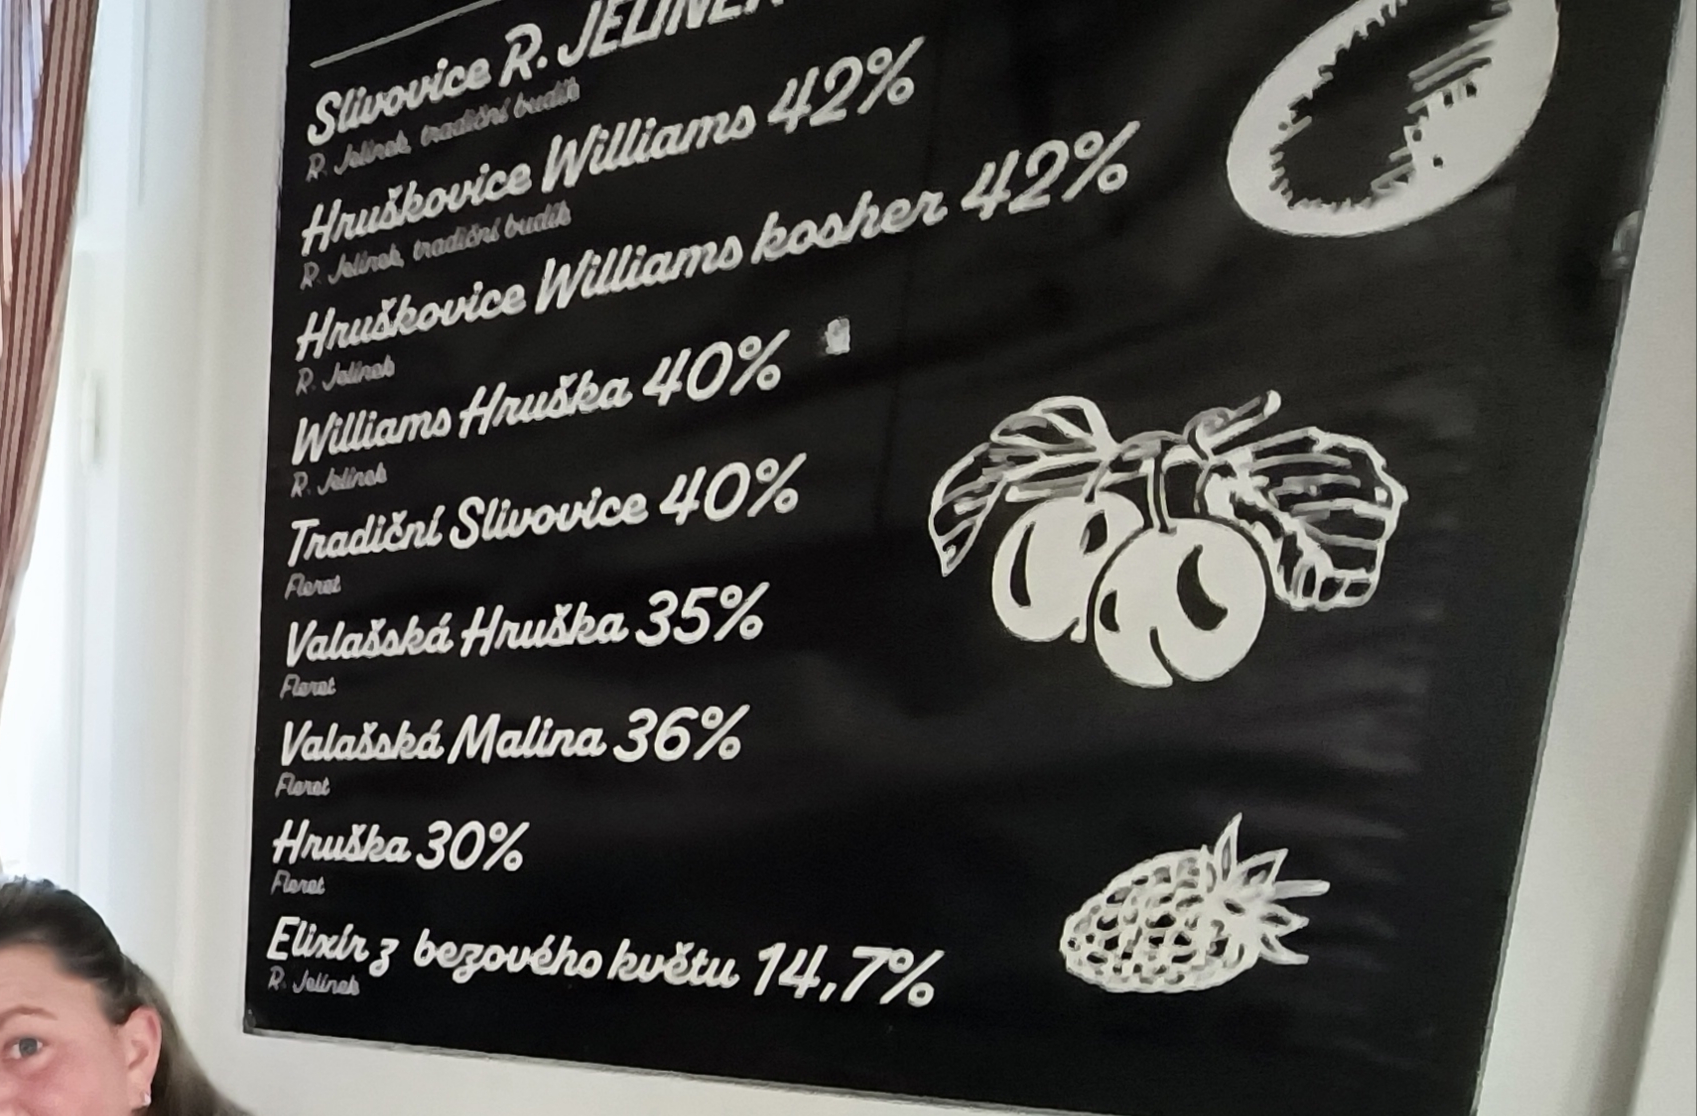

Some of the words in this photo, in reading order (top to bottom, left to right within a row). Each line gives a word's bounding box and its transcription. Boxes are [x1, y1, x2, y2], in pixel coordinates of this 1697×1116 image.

[307, 57, 491, 145] Slivovice
[499, 23, 547, 88] R.
[301, 163, 532, 256] Hruškovice
[542, 105, 756, 193] Williams
[767, 36, 926, 133] 42%
[295, 281, 526, 362] Hruškovice
[537, 238, 743, 312] Williams
[751, 193, 948, 265] kosher
[962, 121, 1140, 218] 42%
[291, 407, 452, 465] Williams
[459, 370, 634, 438] Hruška
[643, 329, 790, 406] 40%
[287, 504, 445, 567] Tradiční
[449, 487, 649, 549] Slivovice
[659, 452, 807, 526] 40%
[286, 612, 454, 667] Valašská
[460, 604, 628, 657] Hruška
[635, 581, 770, 647] 35%
[281, 719, 445, 766] Valašská
[449, 713, 607, 764] Malina
[613, 704, 750, 762] 36%
[272, 819, 412, 864] Hruška
[416, 820, 530, 871] 30%
[266, 916, 369, 962] Elixír
[369, 938, 400, 977] z
[414, 929, 601, 984] bezového
[607, 939, 740, 989] květu
[753, 941, 946, 1007] 14,7%
